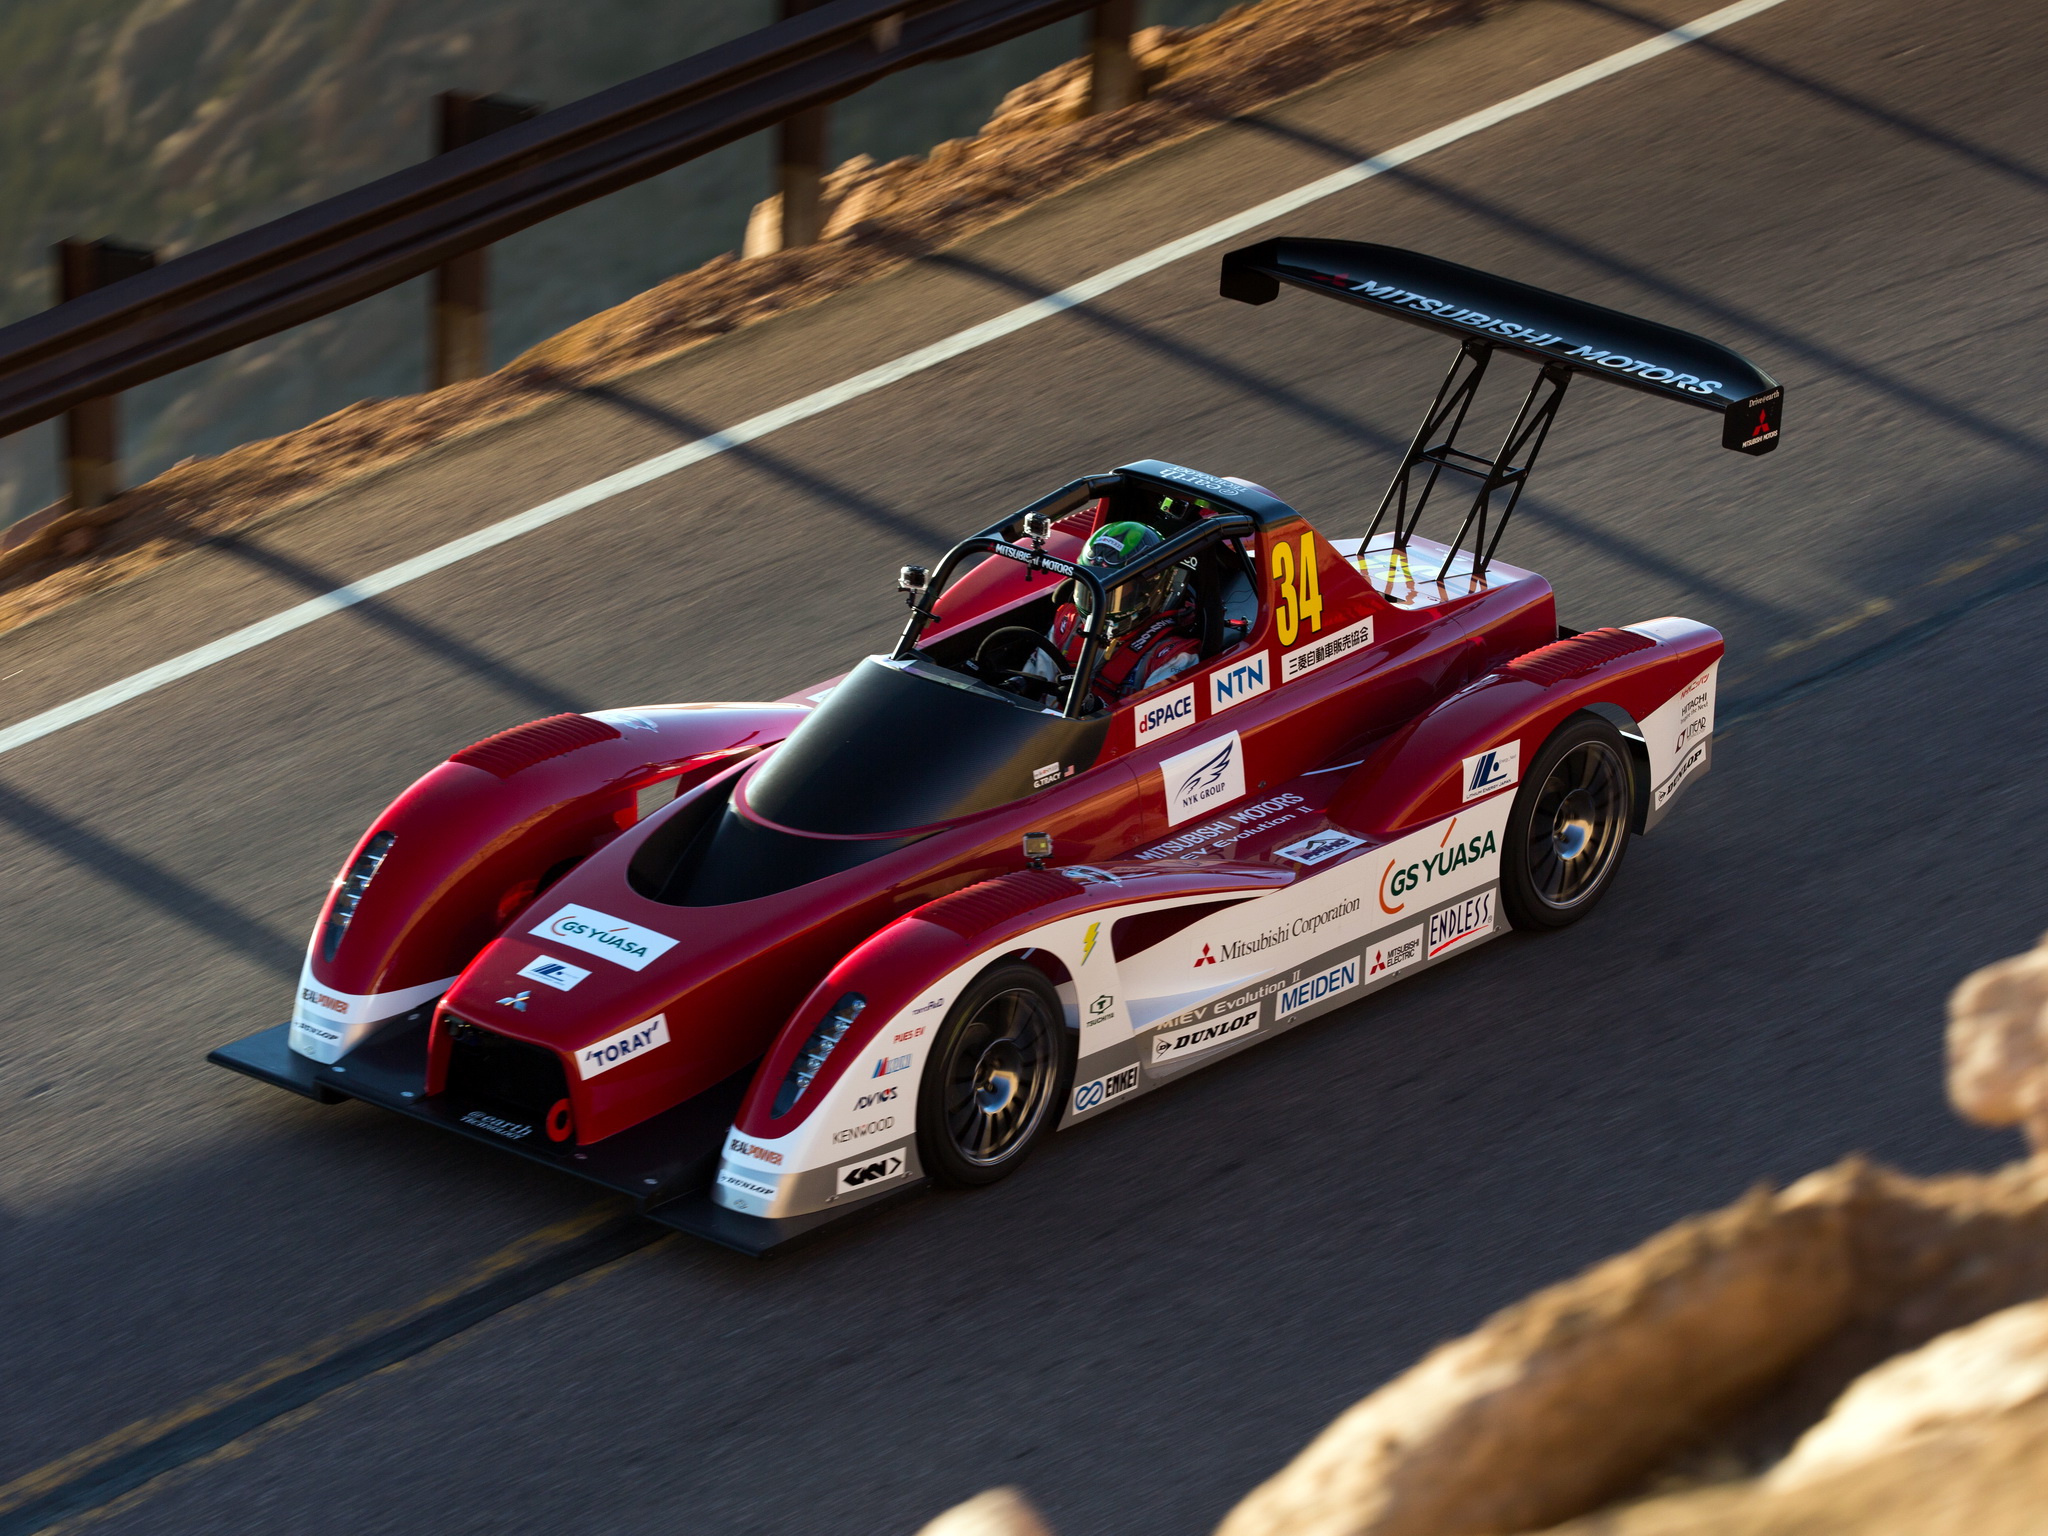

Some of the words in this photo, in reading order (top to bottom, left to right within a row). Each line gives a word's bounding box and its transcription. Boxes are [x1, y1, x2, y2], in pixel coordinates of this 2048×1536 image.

[1350, 280, 1563, 347] MITSUBISHI
[1565, 345, 1723, 395] MOTORS
[1742, 436, 1763, 448] MITSUBISHI
[1763, 430, 1778, 440] MOTORS
[1041, 558, 1074, 576] MOTORS
[1271, 530, 1323, 647] 34
[1288, 626, 1369, 675] 三菱自動車販売協会
[1217, 659, 1264, 703] NTN
[1139, 695, 1192, 733] dSPACE
[1681, 692, 1708, 716] HITACHI
[1666, 749, 1702, 795] DUNLOP
[1182, 794, 1199, 808] NYK
[1200, 782, 1226, 800] GROUP
[1134, 820, 1237, 861] MITSUBISHI
[1228, 793, 1304, 824] MOTORS
[1212, 813, 1297, 848] Evolution
[1391, 863, 1419, 896] GS
[1422, 830, 1496, 882] YUASA
[1219, 923, 1290, 962] Mitsubishi
[1292, 897, 1361, 934] Corporation
[1429, 893, 1490, 947] ENDLESS
[562, 921, 588, 935] GS
[586, 927, 648, 957] YUASA
[1387, 939, 1420, 958] MITSUBISHI
[1386, 949, 1416, 968] ELECTRIC
[1213, 980, 1286, 1014] Evolution
[1281, 962, 1355, 1014] MEIDEN
[1173, 1011, 1257, 1050] DUNLOP
[1105, 1066, 1138, 1099] ENKEI
[832, 1116, 895, 1144] KENWOOD
[727, 1177, 774, 1195] DUNLOP
